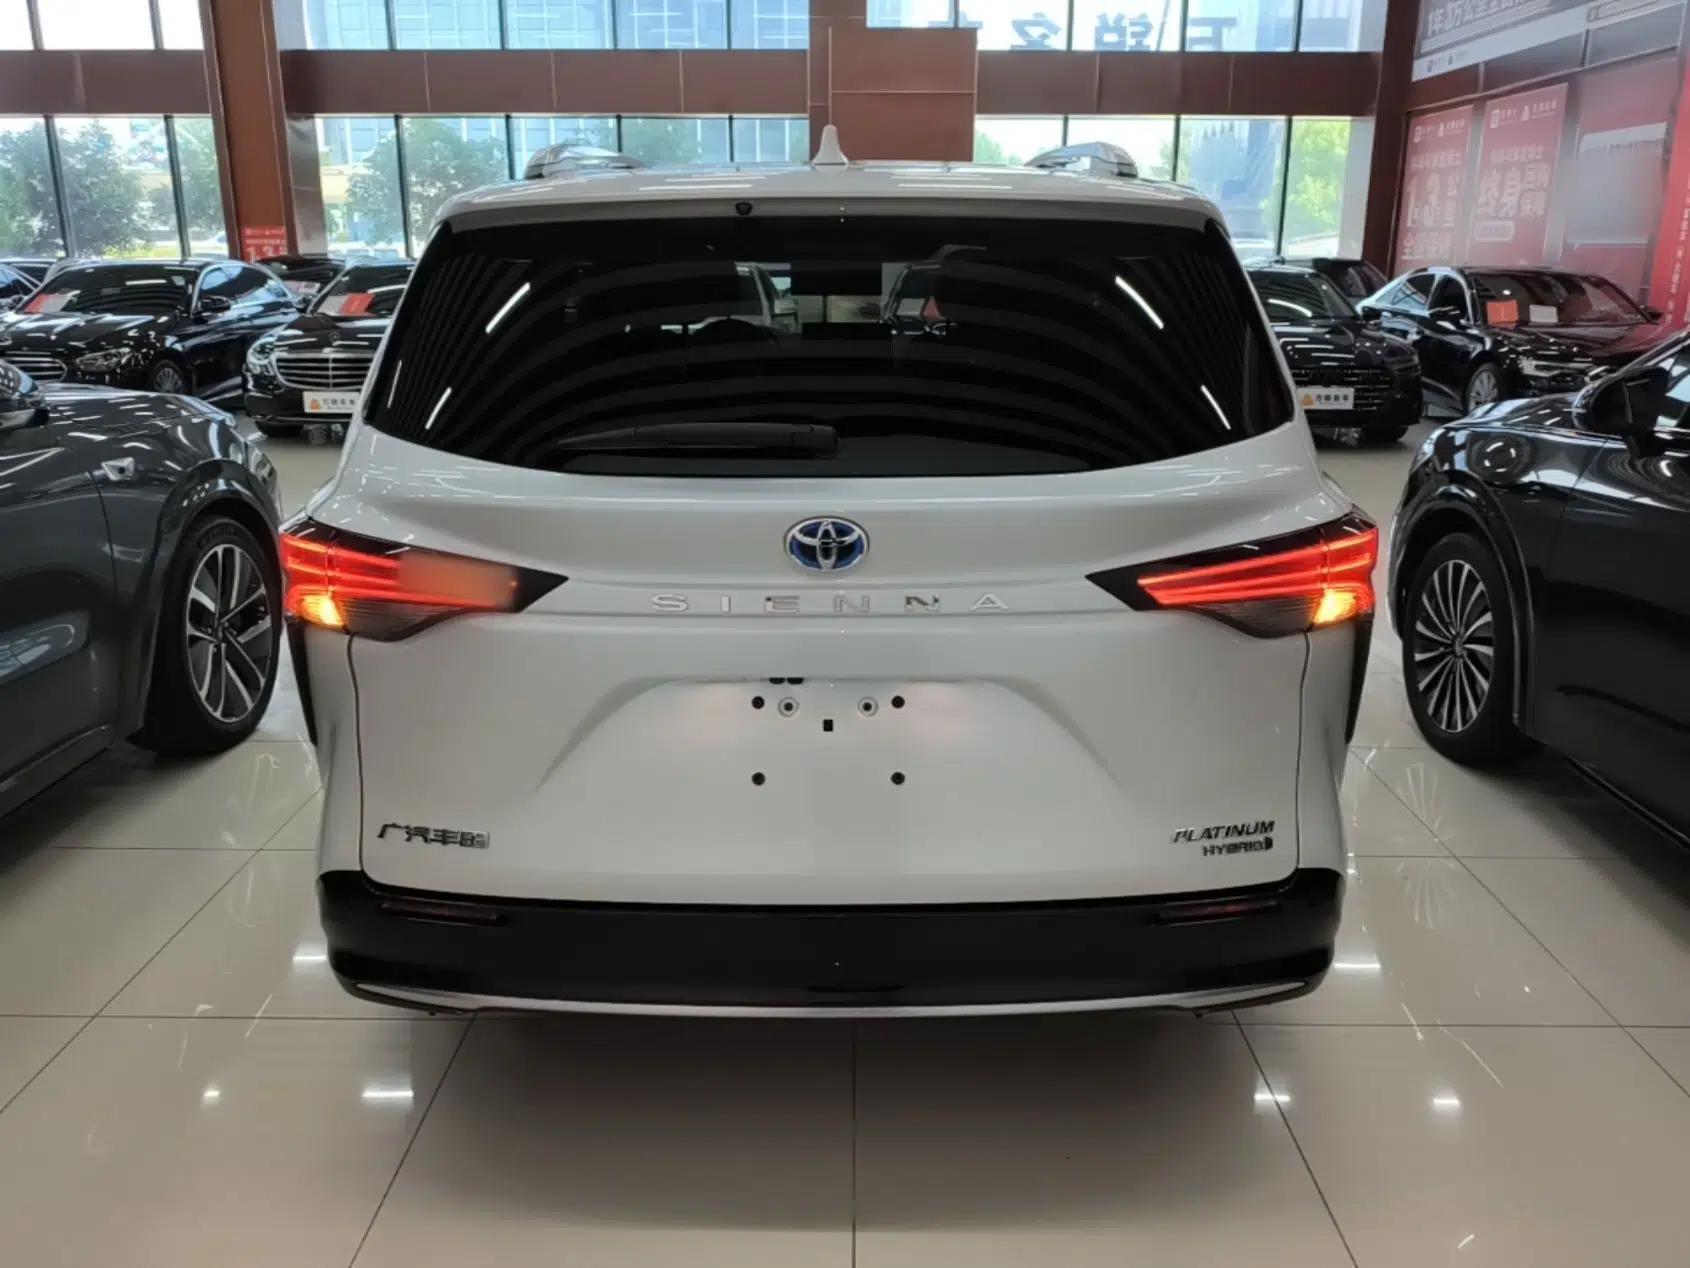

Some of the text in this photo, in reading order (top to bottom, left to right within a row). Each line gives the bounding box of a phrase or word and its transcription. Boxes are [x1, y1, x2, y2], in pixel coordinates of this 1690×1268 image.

[651, 593, 1010, 614] SIENNA
[1173, 820, 1276, 843] PLATINUM
[1202, 839, 1264, 857] HYBRID
